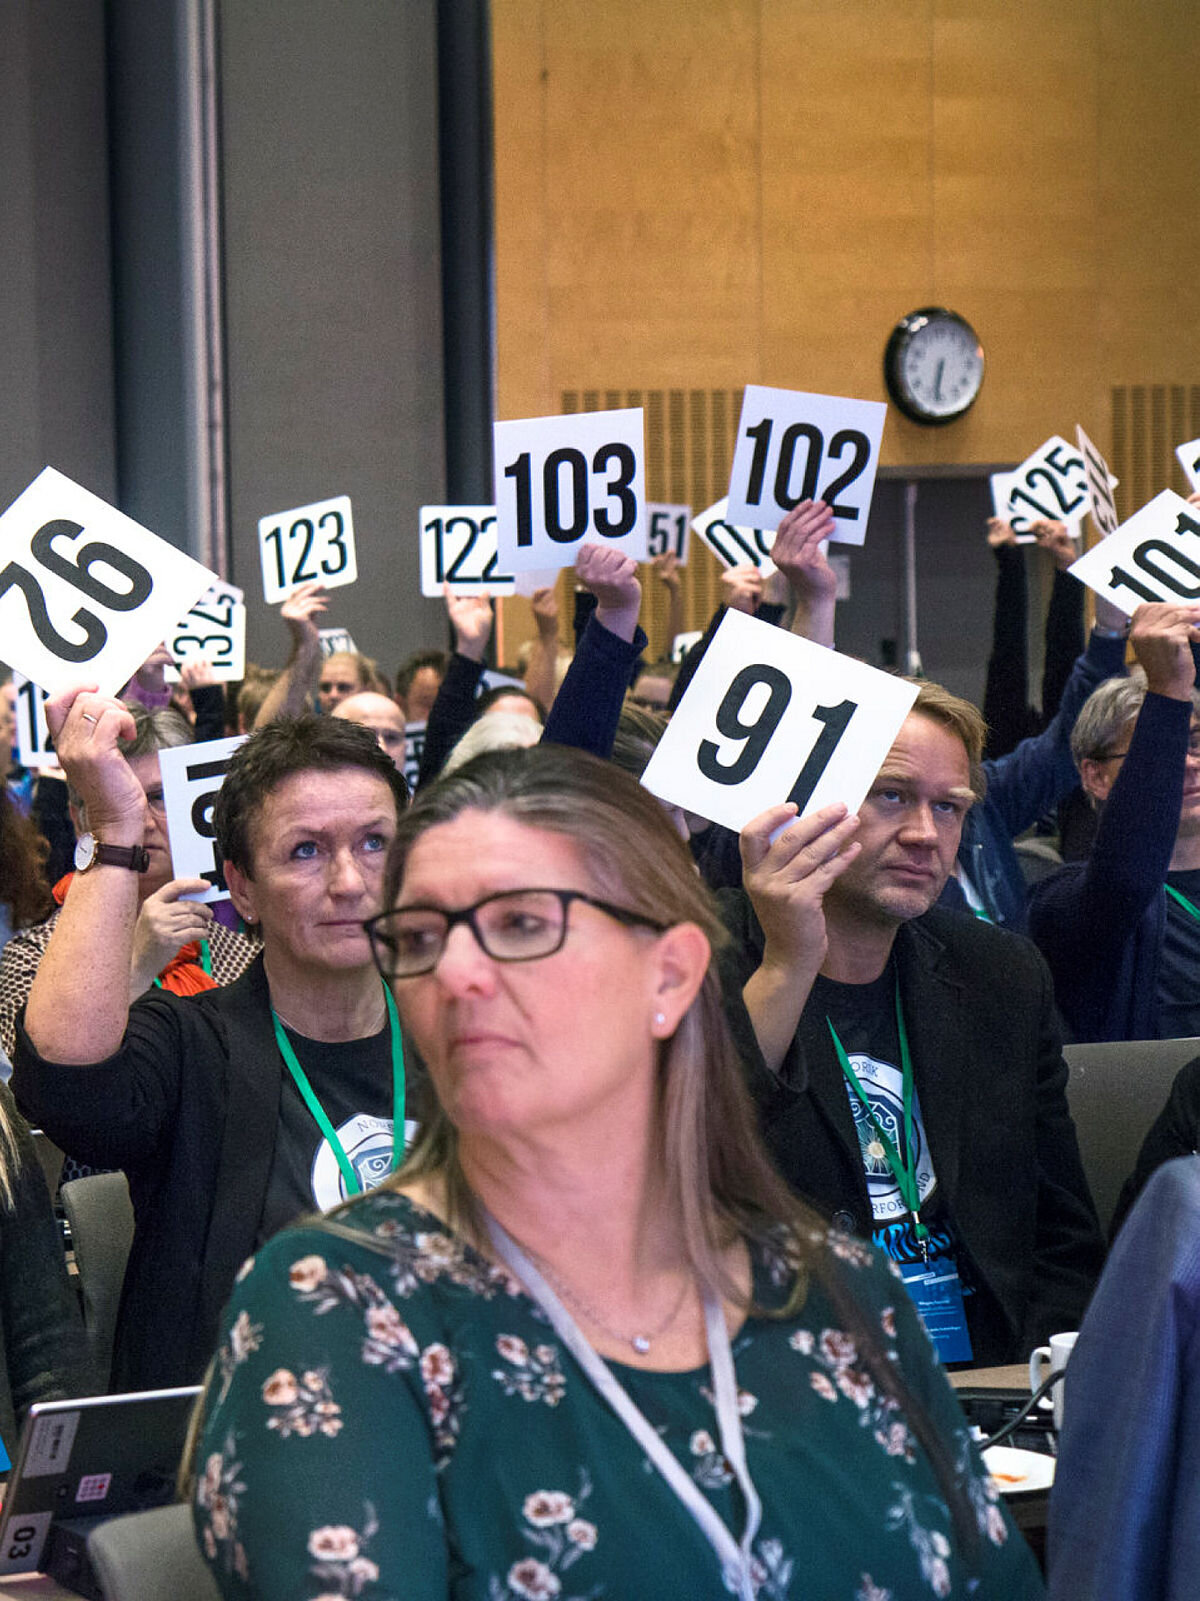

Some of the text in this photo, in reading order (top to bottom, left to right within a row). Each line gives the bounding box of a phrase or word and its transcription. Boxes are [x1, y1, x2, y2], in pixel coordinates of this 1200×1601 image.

[504, 442, 638, 548] 103
[746, 418, 871, 521] 102
[1010, 446, 1088, 520] 125
[265, 511, 348, 590] 123
[425, 516, 514, 583] 122
[648, 511, 687, 558] 51
[697, 663, 858, 817] 91
[8, 1526, 36, 1560] 03
